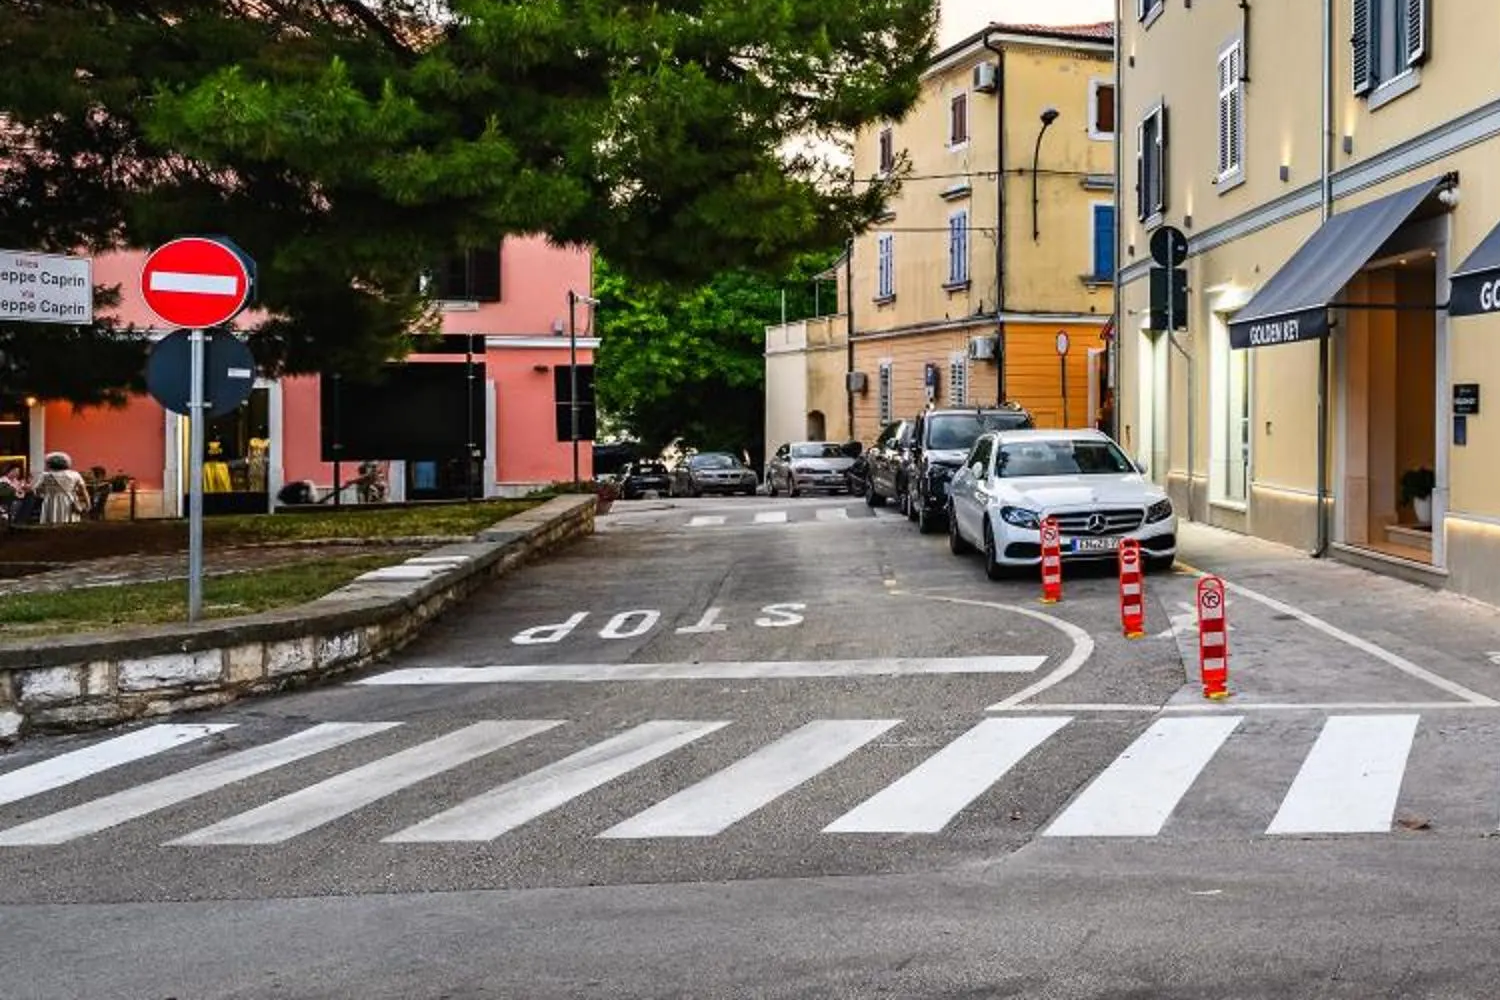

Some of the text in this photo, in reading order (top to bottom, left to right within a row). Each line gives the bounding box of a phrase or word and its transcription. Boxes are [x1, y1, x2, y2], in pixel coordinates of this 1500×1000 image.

[40, 271, 86, 288] Caprin
[40, 299, 86, 316] Caprin
[1249, 319, 1299, 345] GOLDEN KEY
[511, 603, 807, 645] STOP
